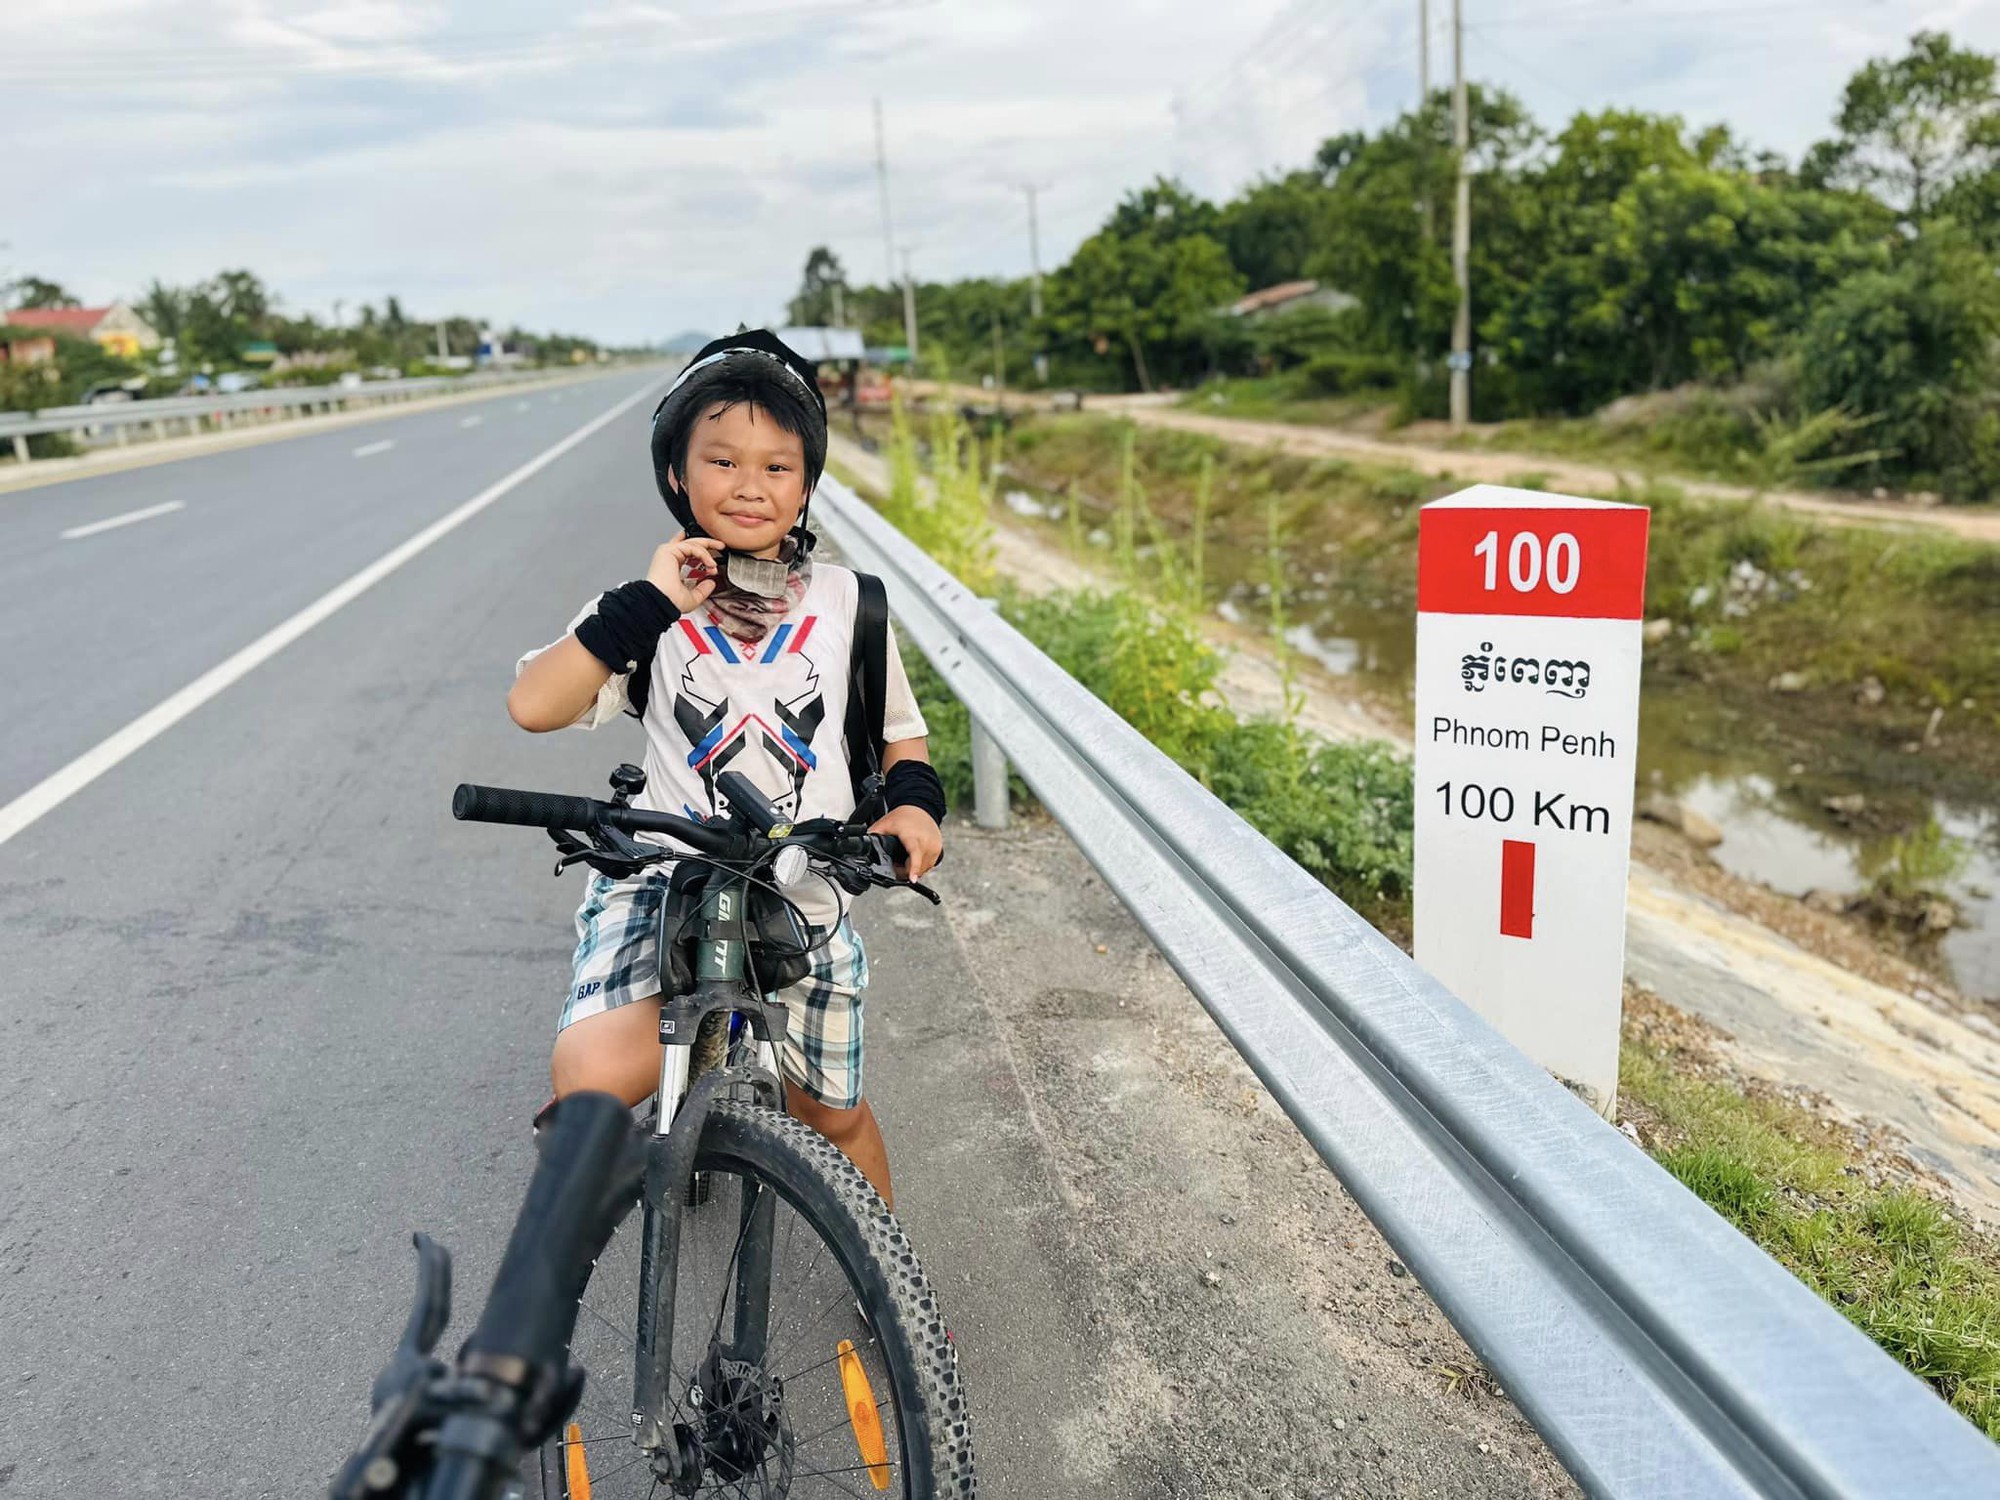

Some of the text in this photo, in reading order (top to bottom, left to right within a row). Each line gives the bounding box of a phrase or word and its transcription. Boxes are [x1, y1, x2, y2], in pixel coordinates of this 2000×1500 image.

[1474, 531, 1581, 594] 100
[1461, 641, 1590, 699] ភ្នំពេញ
[1434, 717, 1615, 758] Phnom Penh
[1436, 781, 1610, 834] 100 Km
[714, 891, 731, 976] GINT
